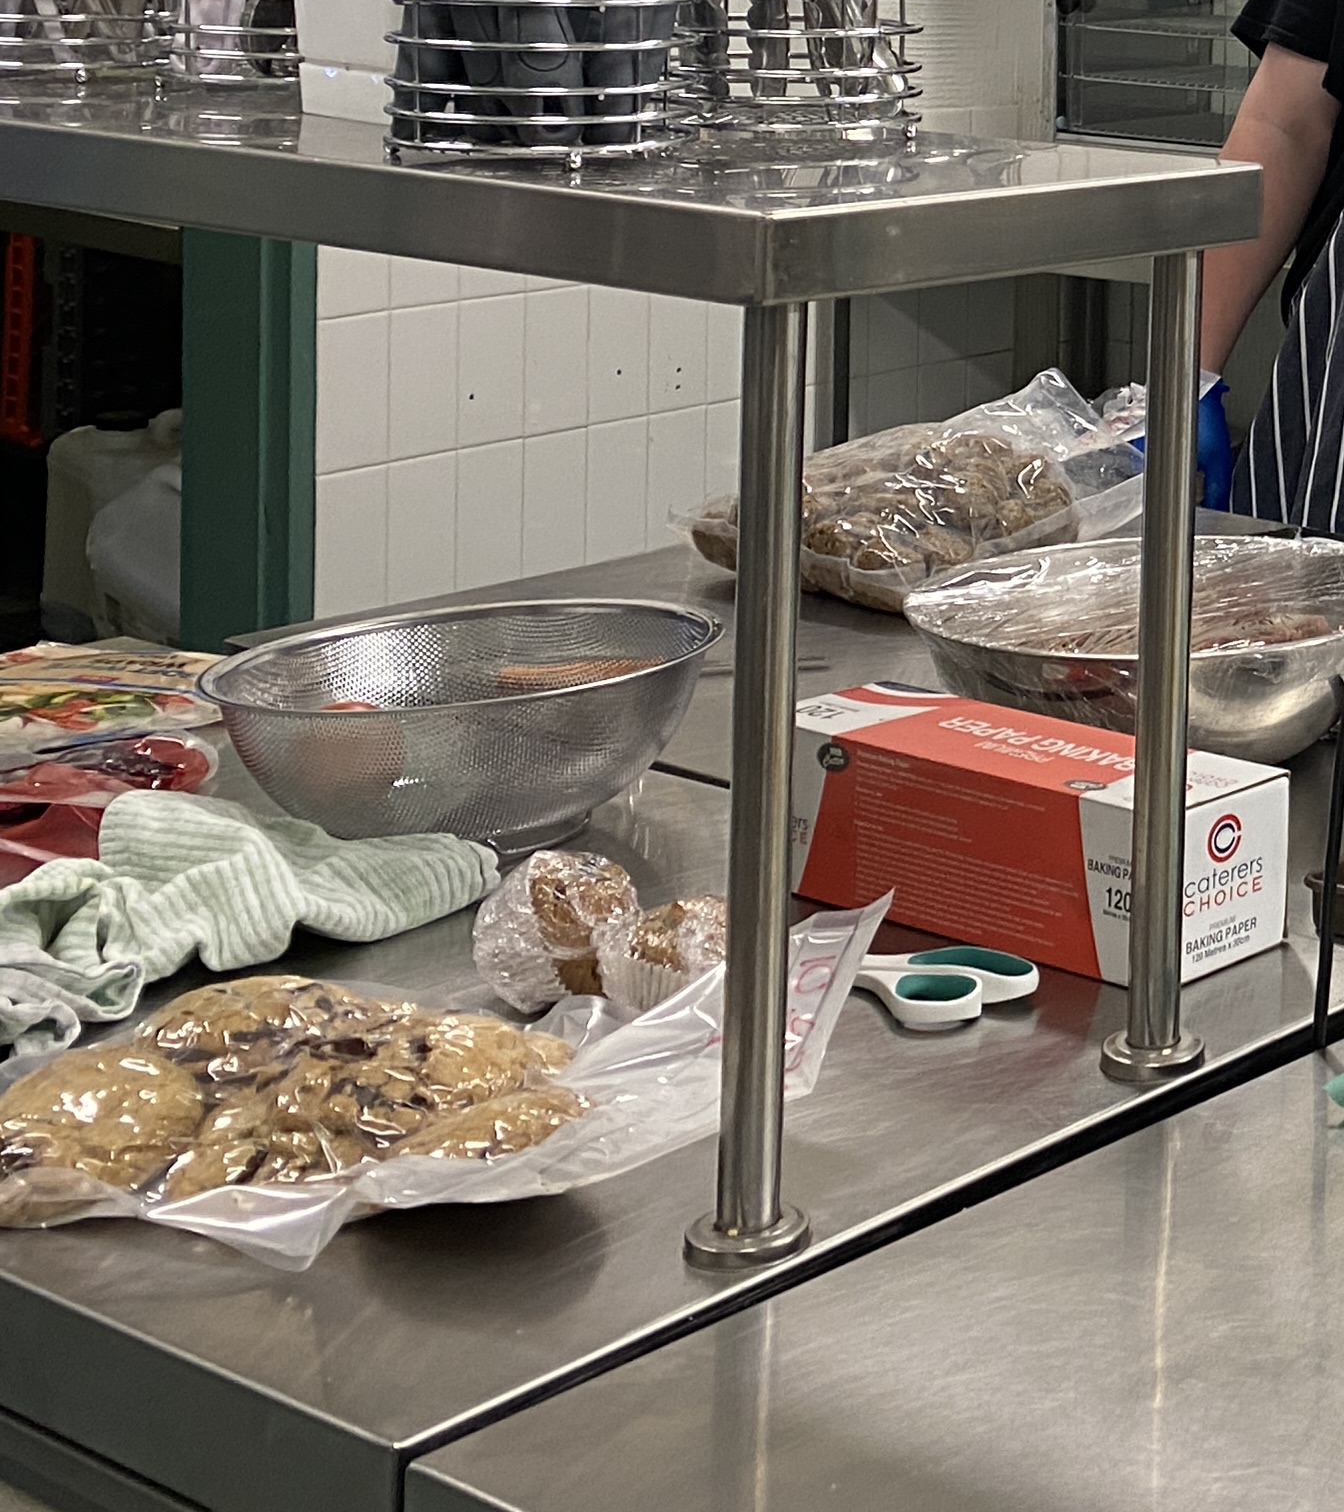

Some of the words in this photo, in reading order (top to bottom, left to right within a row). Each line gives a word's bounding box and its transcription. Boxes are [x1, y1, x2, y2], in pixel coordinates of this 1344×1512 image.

[937, 717, 1037, 745] PAPER
[1031, 735, 1135, 771] BAKING
[1087, 858, 1122, 879] BAKING
[1184, 856, 1264, 899] caterers
[1183, 875, 1264, 919] CHOICE
[1185, 930, 1224, 955] BAKING
[1224, 916, 1257, 939] PAPER
